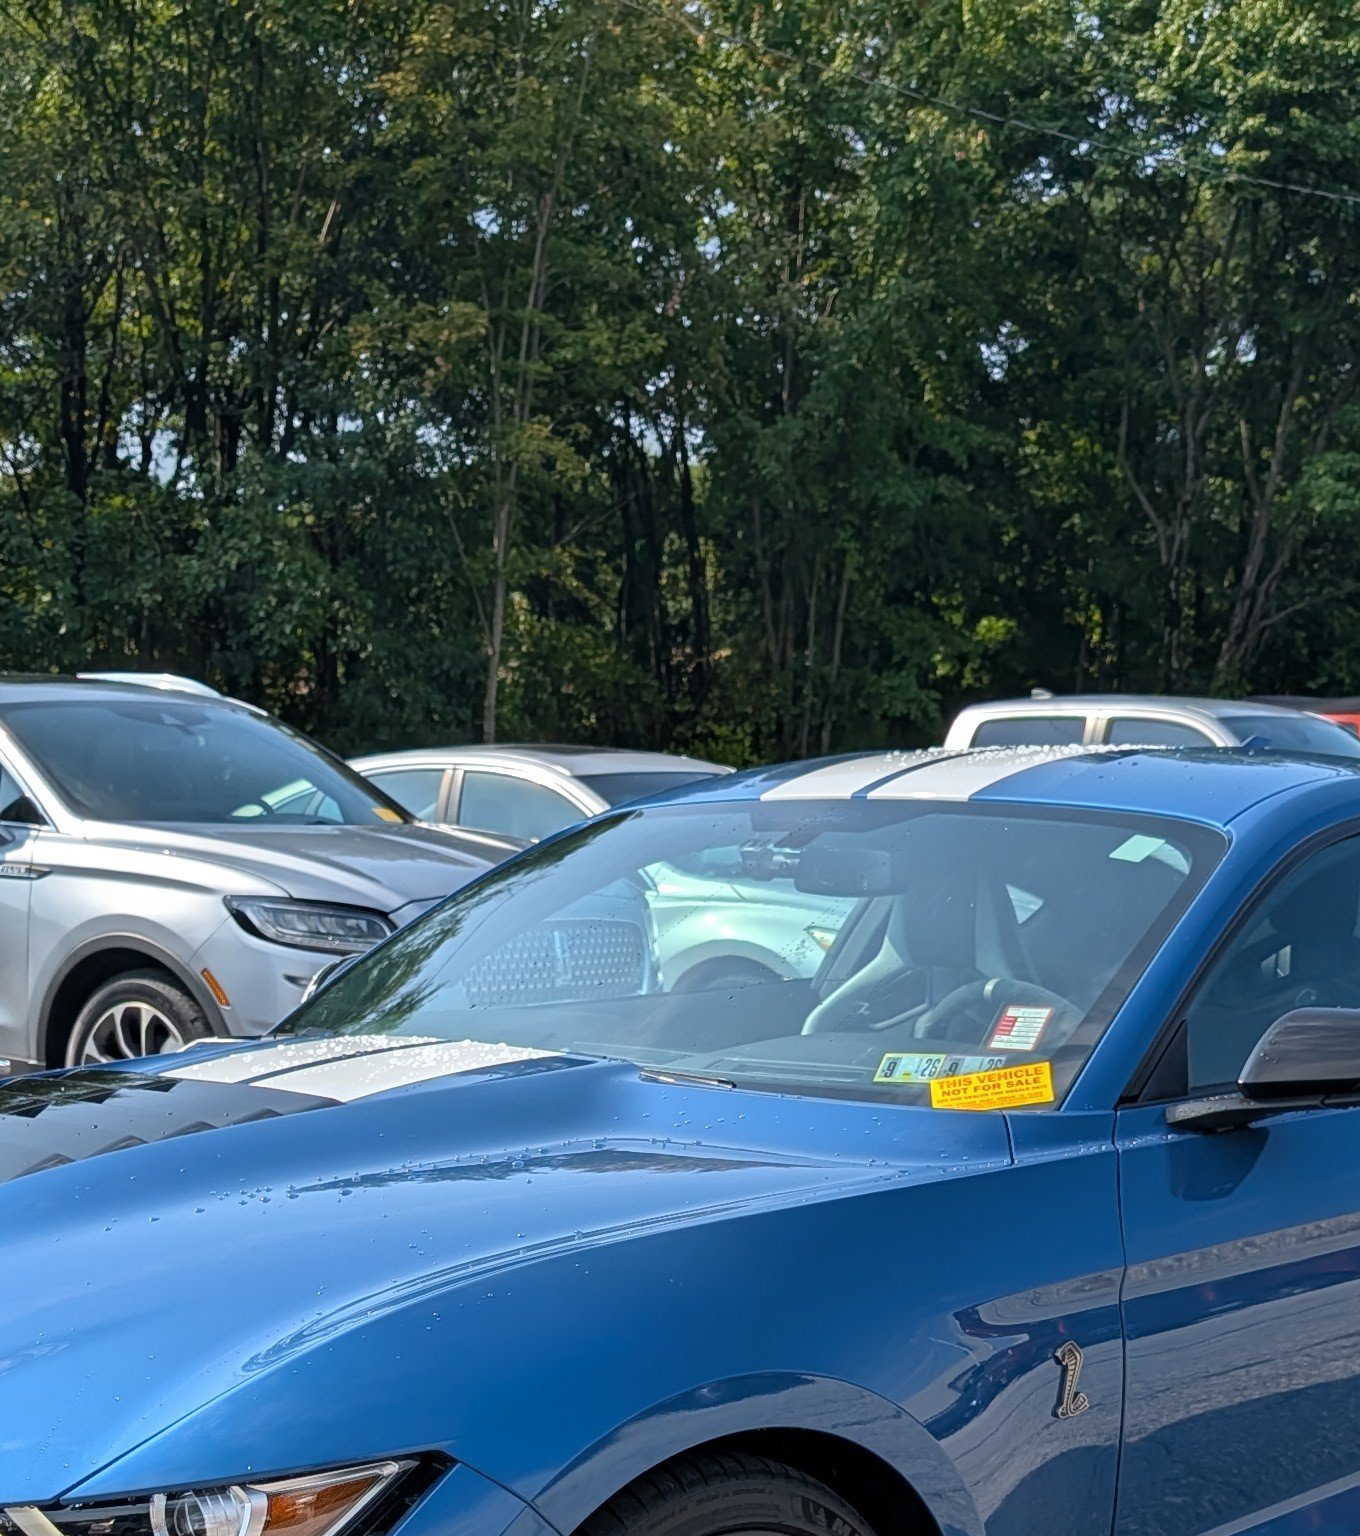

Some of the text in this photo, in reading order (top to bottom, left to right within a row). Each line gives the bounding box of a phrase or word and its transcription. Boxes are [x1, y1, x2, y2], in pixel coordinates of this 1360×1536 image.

[884, 1061, 898, 1078] 9
[937, 1066, 1044, 1091] THIS VEHICLE
[941, 1077, 1041, 1098] NOT FOR SALE
